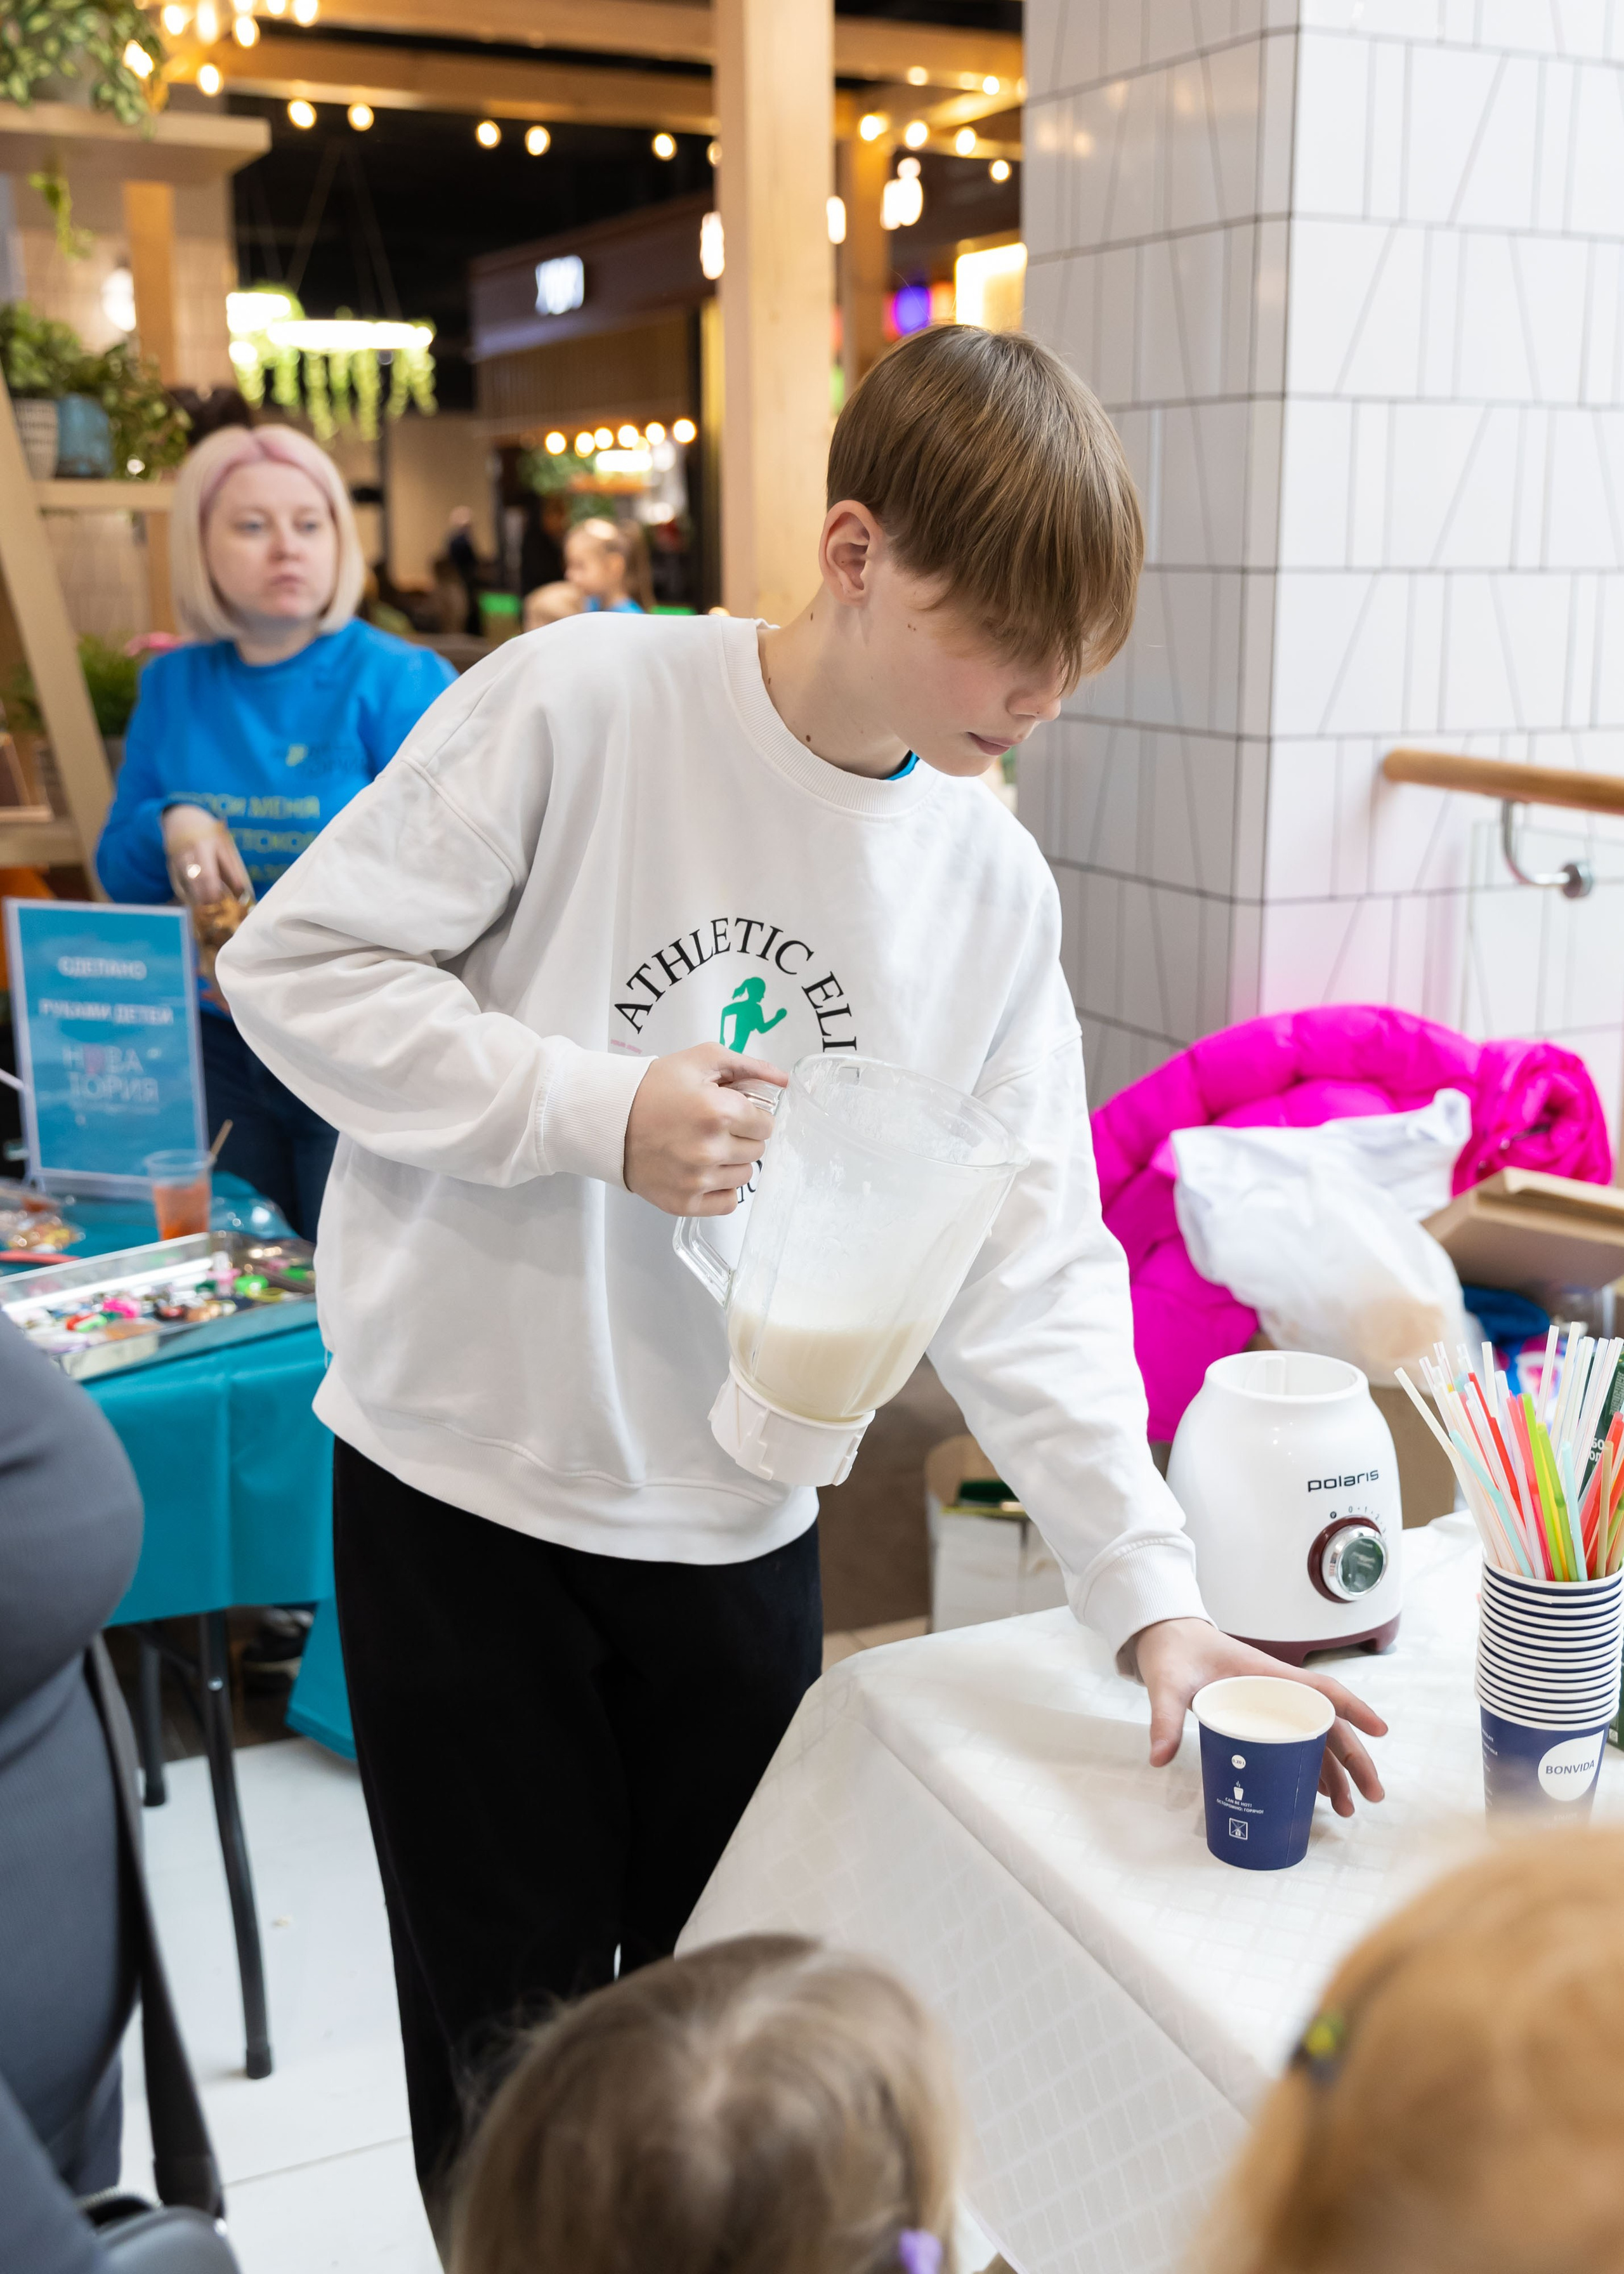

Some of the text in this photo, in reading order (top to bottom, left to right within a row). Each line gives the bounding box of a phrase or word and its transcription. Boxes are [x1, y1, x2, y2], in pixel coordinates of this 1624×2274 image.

[614, 917, 857, 1053] ATHLETIC ELI
[1307, 1469, 1379, 1492] polaris
[1545, 1759, 1595, 1775] BONVIDA
